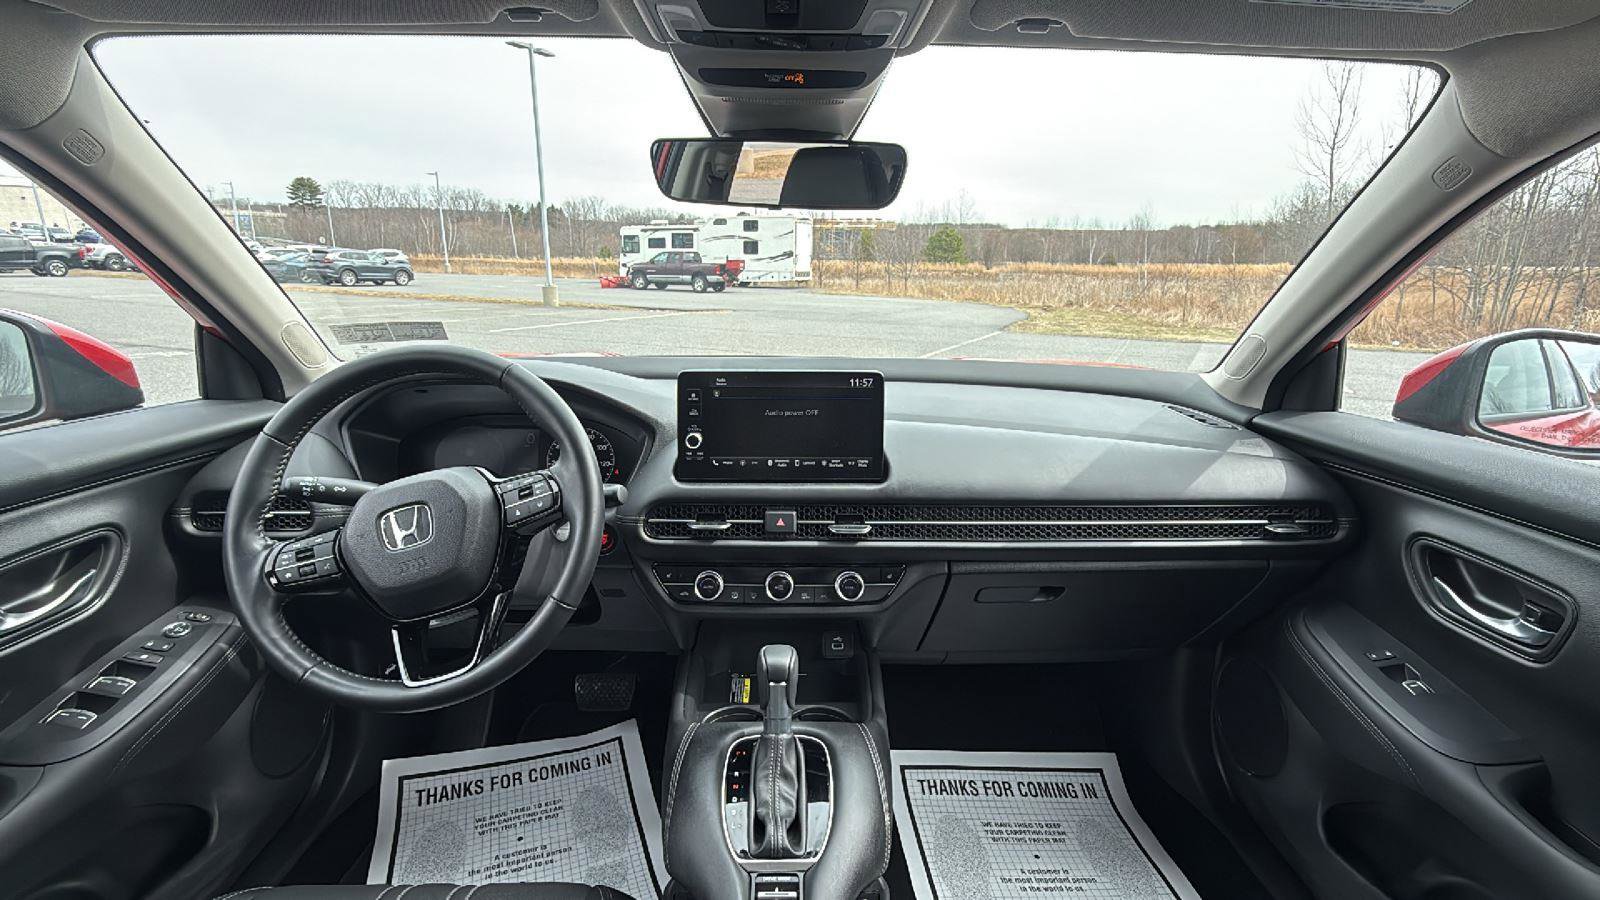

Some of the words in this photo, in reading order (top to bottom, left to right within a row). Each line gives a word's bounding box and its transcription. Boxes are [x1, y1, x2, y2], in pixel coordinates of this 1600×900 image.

[849, 378, 874, 388] 11:57
[415, 779, 484, 806] THANKS
[490, 771, 524, 792] FOR
[528, 757, 592, 784] COMING
[597, 751, 612, 767] IN
[917, 779, 980, 797] THANKS
[983, 780, 1016, 798] FOR
[1017, 781, 1078, 799] COMING
[1081, 782, 1099, 800] IN
[475, 816, 487, 824] WE
[490, 810, 508, 821] HAVE
[510, 806, 532, 815] TRIED
[545, 798, 562, 808] KEEP
[475, 821, 496, 831] YOUR
[498, 811, 540, 826] CARPETING
[540, 805, 564, 815] CLEAN
[478, 826, 501, 837] WITH
[501, 822, 518, 832] THIS
[519, 816, 543, 827] PAPER
[544, 812, 560, 822] MAT
[468, 869, 481, 877] the
[483, 861, 504, 873] most
[506, 852, 544, 867] important
[545, 846, 572, 859] person
[501, 846, 539, 860] customer
[494, 868, 509, 878] the
[510, 862, 533, 874] world
[534, 860, 543, 868] to
